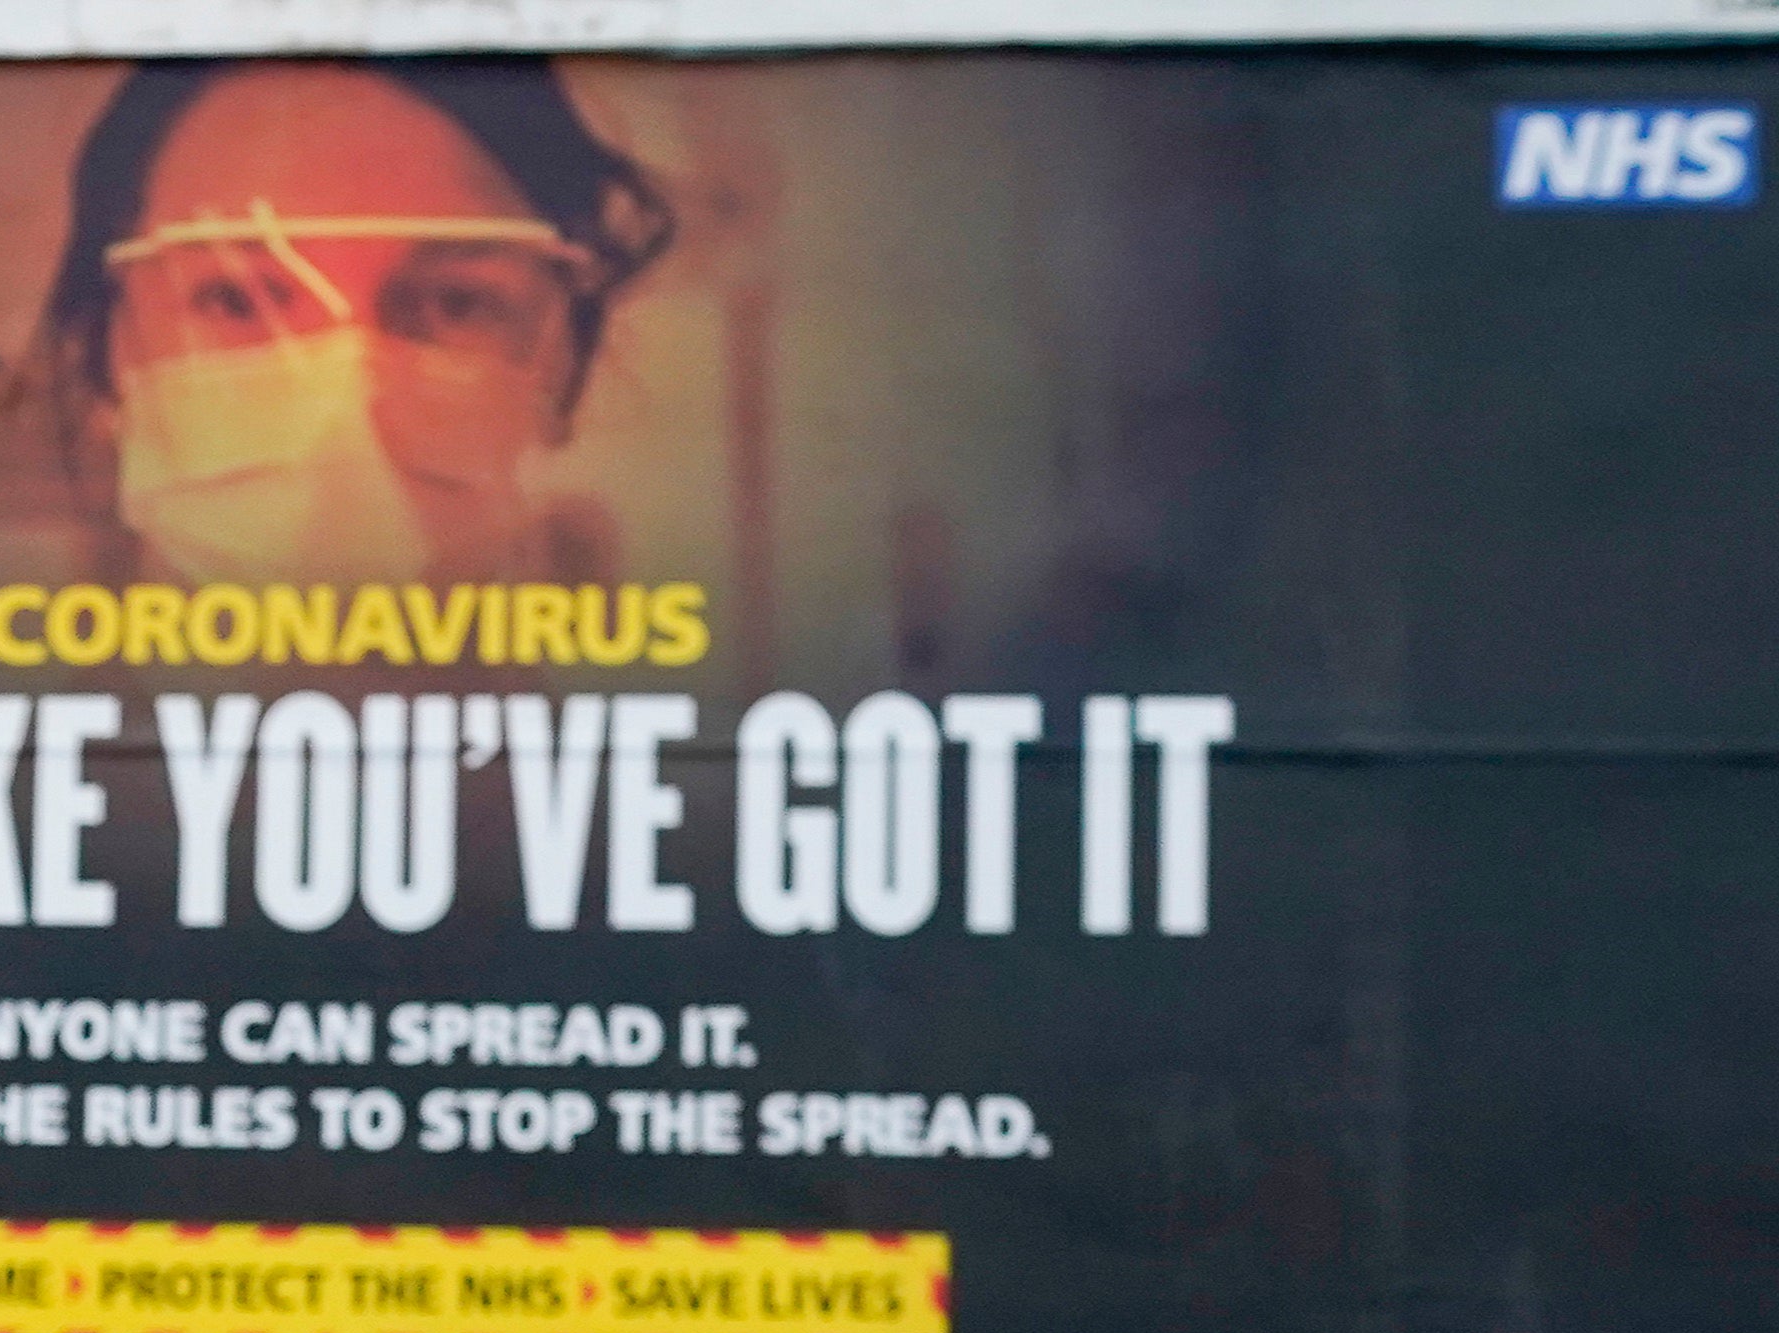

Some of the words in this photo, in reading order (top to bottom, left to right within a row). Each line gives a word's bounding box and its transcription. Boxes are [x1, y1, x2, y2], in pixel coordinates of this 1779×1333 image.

[1500, 107, 1754, 201] NHS
[155, 690, 698, 934] YOU'VE
[735, 690, 1044, 937] GOT
[1080, 693, 1236, 937] IT
[220, 1000, 374, 1064] CAN
[388, 1002, 665, 1066] SPREAD
[679, 1004, 758, 1068] IT.
[82, 1083, 297, 1150] RULES
[310, 1086, 404, 1152] TO
[418, 1088, 596, 1153] STOP
[609, 1090, 743, 1156] THE
[757, 1092, 1052, 1159] SPREAD.
[98, 1261, 326, 1313] PROTECT
[348, 1266, 442, 1315] THE
[458, 1268, 566, 1316] NHS
[611, 1270, 740, 1318] SAVE
[758, 1272, 906, 1321] LIVES
